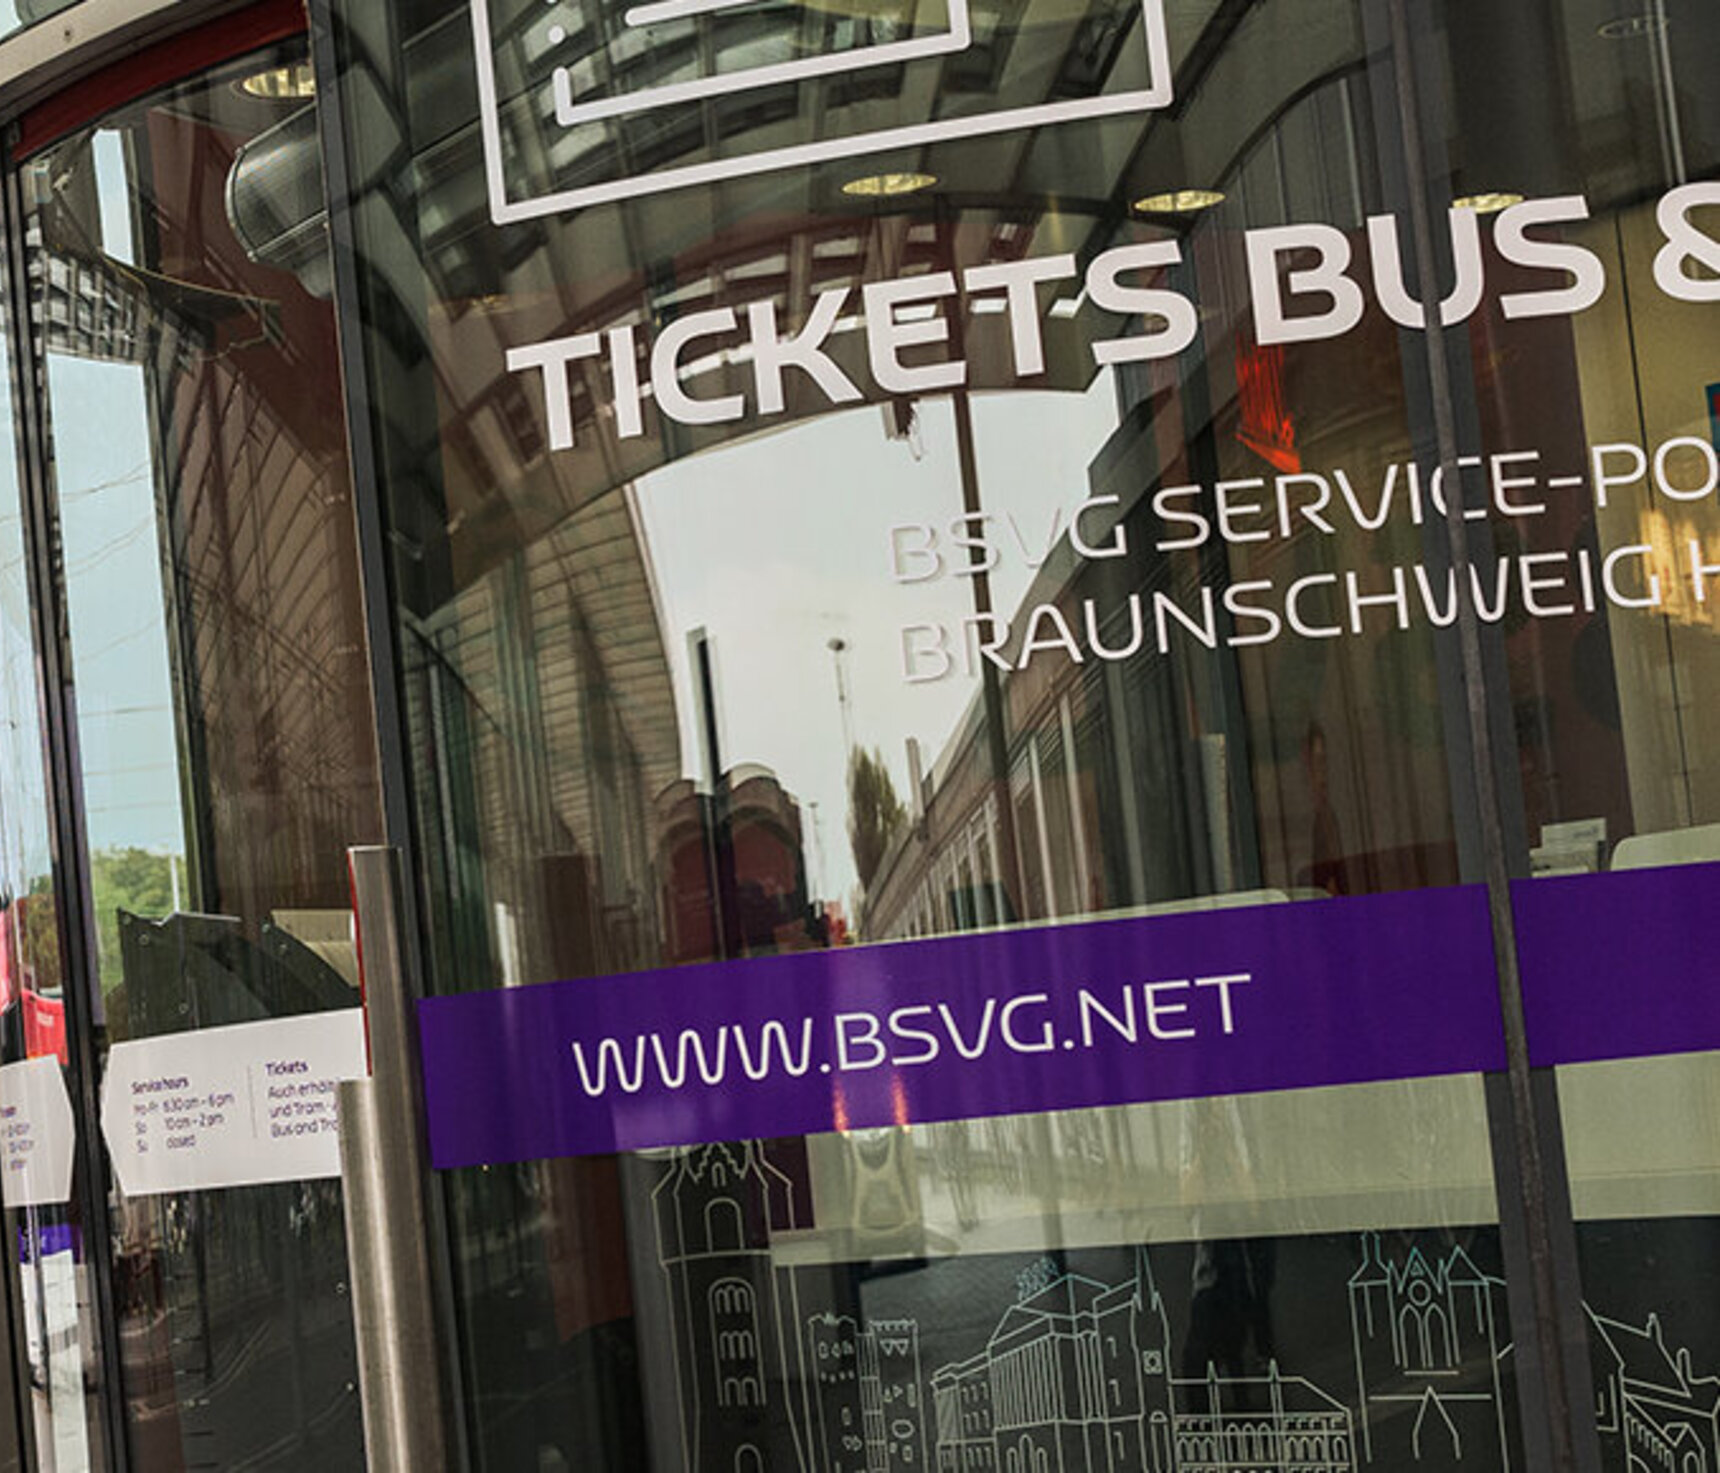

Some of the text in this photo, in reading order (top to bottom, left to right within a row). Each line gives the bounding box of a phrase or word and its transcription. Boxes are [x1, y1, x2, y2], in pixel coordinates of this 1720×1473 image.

[506, 239, 1199, 452] TICKETS
[1245, 194, 1606, 346] BUS
[891, 436, 1719, 585] BSVG SERVICE-PO
[900, 544, 1662, 685] BRAUNSCHWEIG
[572, 974, 1251, 1096] WWW.BSVG.NET
